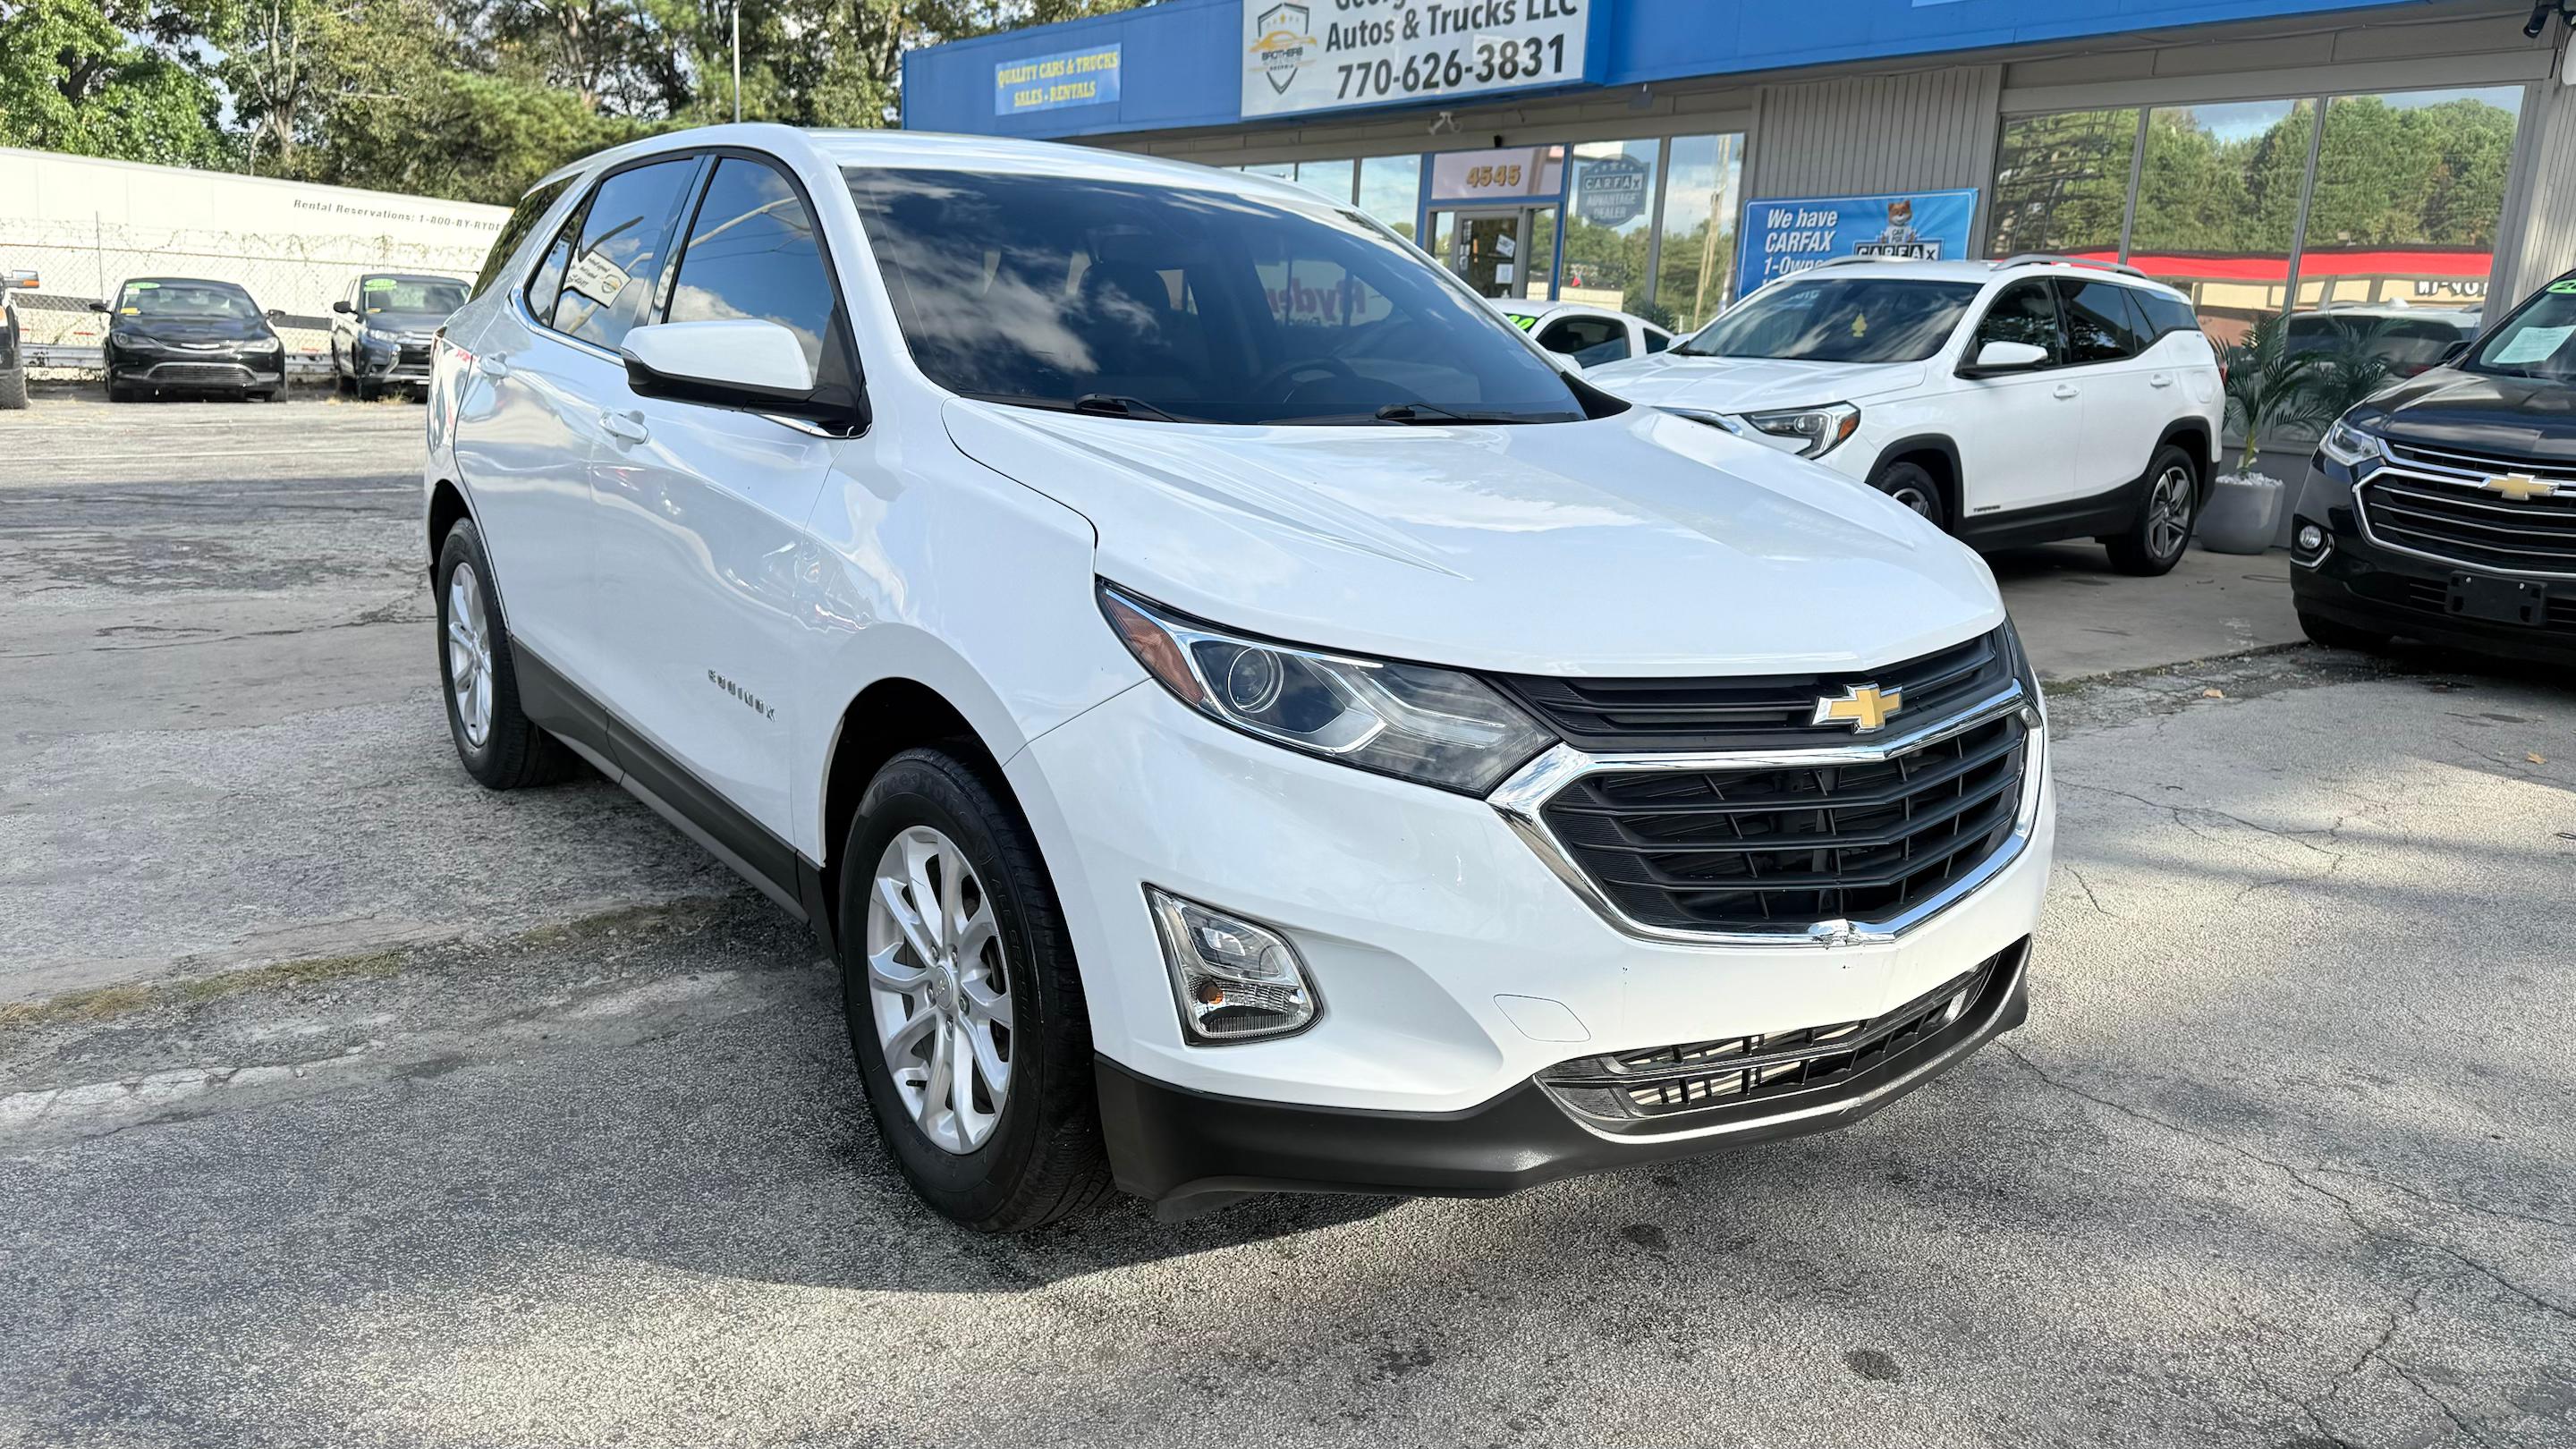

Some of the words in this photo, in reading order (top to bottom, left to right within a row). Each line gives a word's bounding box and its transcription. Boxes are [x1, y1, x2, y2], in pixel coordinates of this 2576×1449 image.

[1326, 18, 1395, 52] Autos
[1402, 9, 1420, 41] &
[1427, 0, 1517, 37] Trucks
[997, 64, 1038, 88] QUALITY
[1039, 60, 1064, 79] CARS
[1066, 57, 1075, 75] &
[1076, 51, 1118, 73] TRUCKS
[1337, 33, 1565, 99] 770-626-3831
[1014, 88, 1043, 107] SALES
[1050, 80, 1097, 103] RENTALS
[1466, 165, 1521, 188] 4545
[1584, 173, 1643, 191] CARFAX
[293, 199, 332, 213] Rental
[336, 203, 415, 223] Reservations:
[1587, 192, 1637, 207] ADVANTAGE
[1593, 206, 1627, 220] DEALER
[1767, 208, 1793, 229] We
[1795, 207, 1839, 228] have
[1765, 230, 1837, 253] CARFAX
[1857, 245, 1936, 261] CARFAX
[708, 669, 775, 723] EQUINOX
